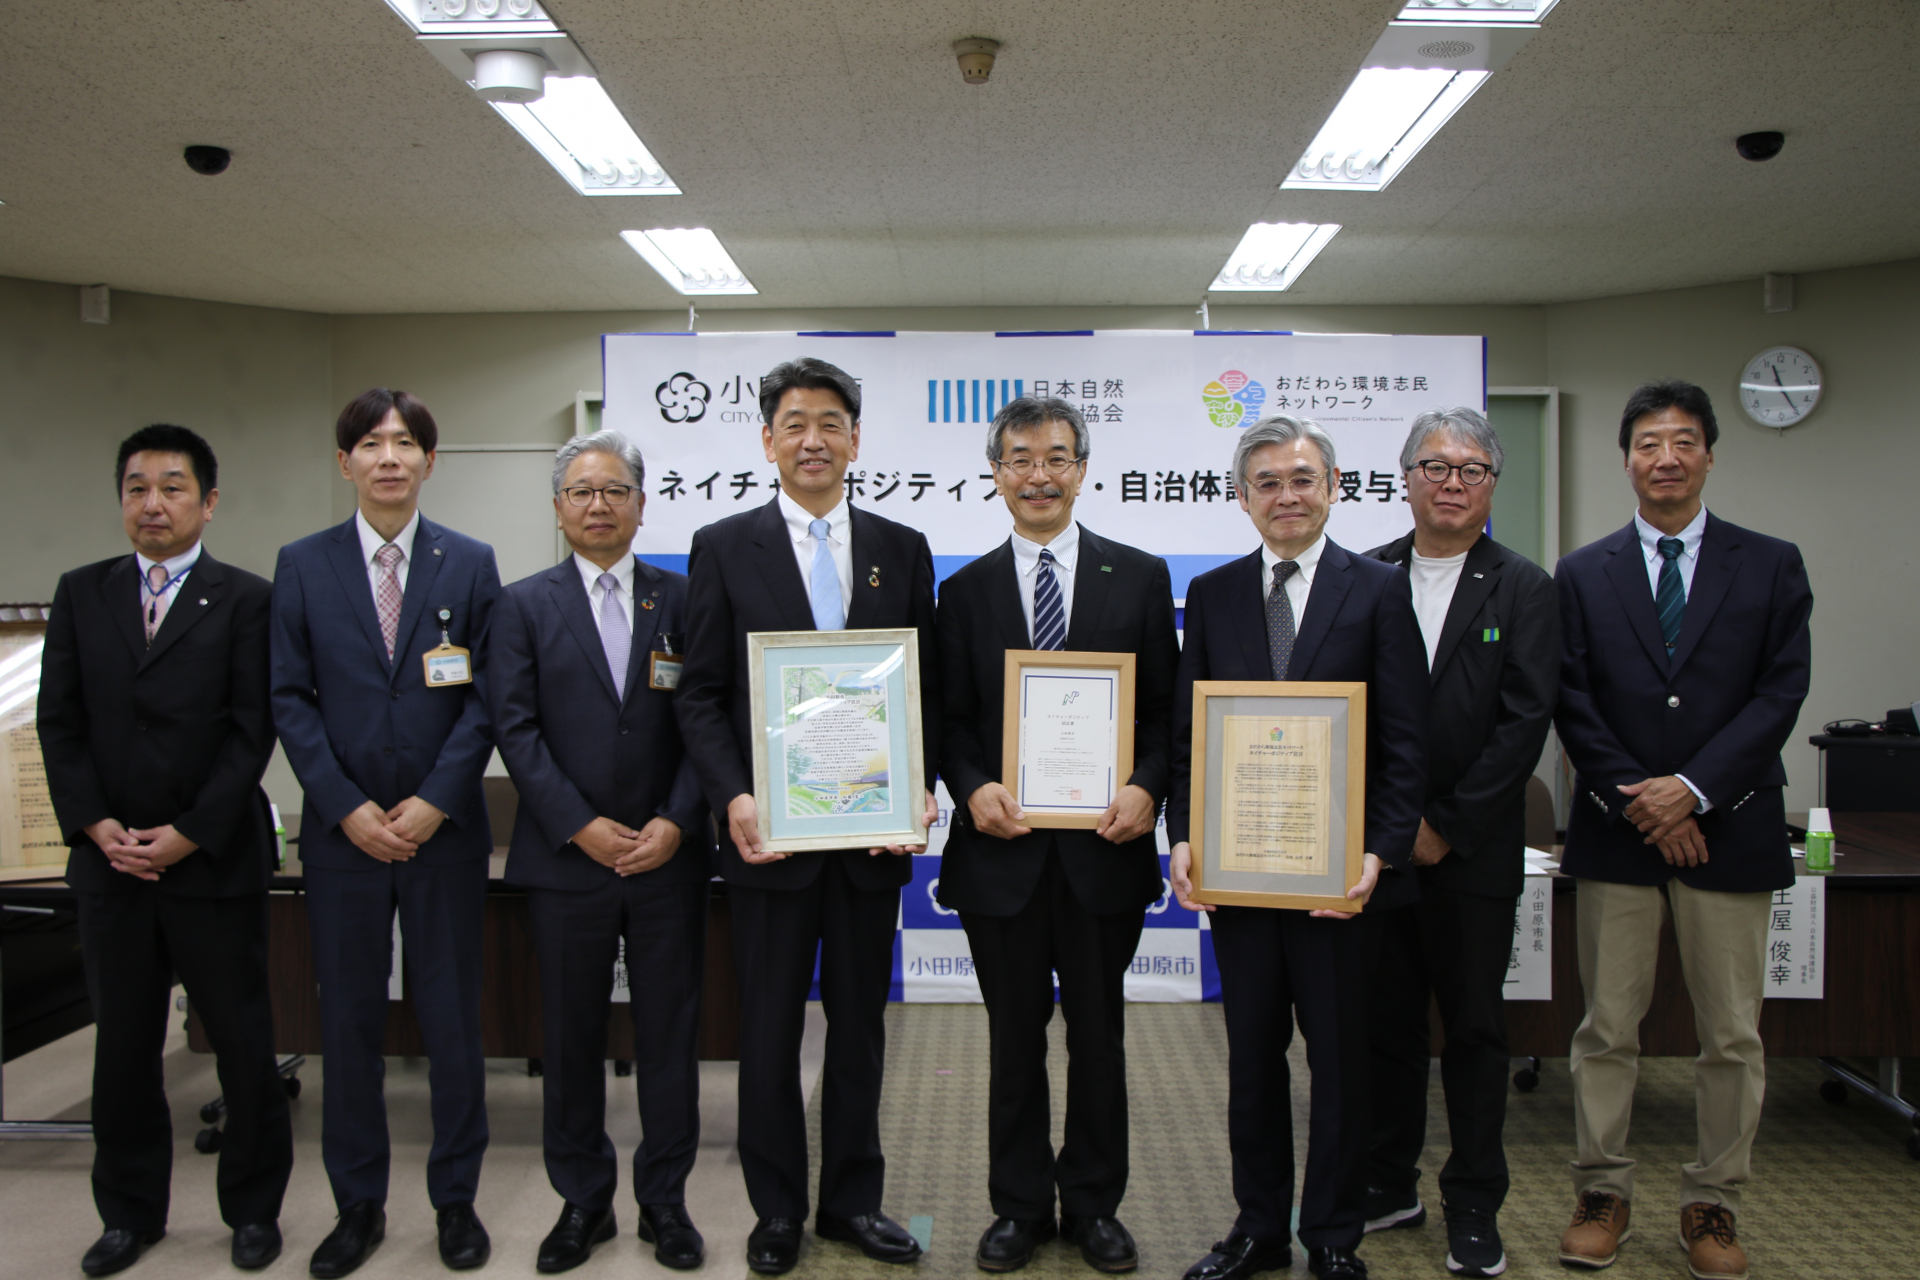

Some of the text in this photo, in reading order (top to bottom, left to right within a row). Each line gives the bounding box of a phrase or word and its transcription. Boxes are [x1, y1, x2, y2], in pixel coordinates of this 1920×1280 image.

[1777, 355, 1785, 363] 12
[1753, 372, 1760, 380] 10
[1803, 366, 1809, 374] 2
[1034, 379, 1124, 398] 日本自然
[1276, 376, 1429, 391] おだわら環境志民
[1277, 395, 1373, 410] ネットワーク
[720, 412, 754, 423] CITY
[1079, 403, 1124, 423] 協会
[1532, 888, 1545, 952] 小田原市長
[909, 956, 975, 976] 小田原
[1131, 956, 1195, 976] 田原市
